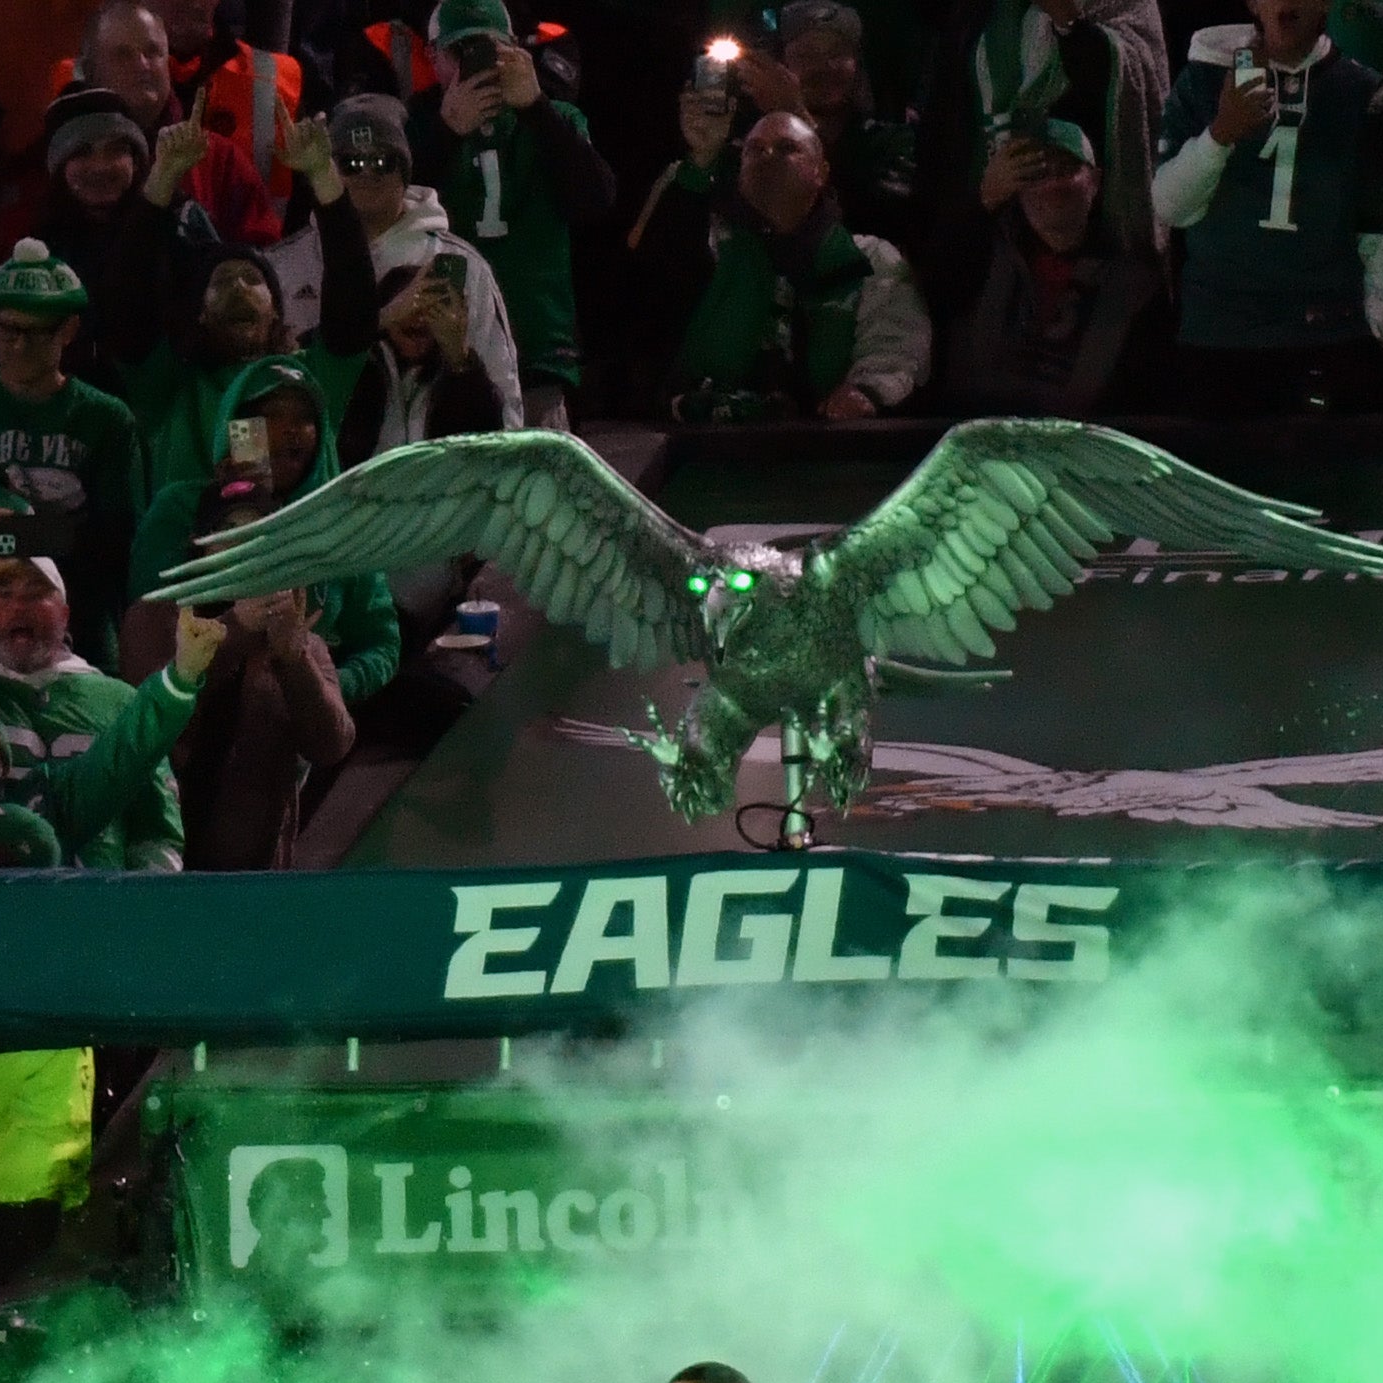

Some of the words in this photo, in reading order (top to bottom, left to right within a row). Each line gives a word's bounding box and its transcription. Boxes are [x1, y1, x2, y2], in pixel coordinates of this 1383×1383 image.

[474, 148, 509, 239] 1
[1258, 126, 1298, 232] 1
[444, 867, 1120, 999] EAGLES
